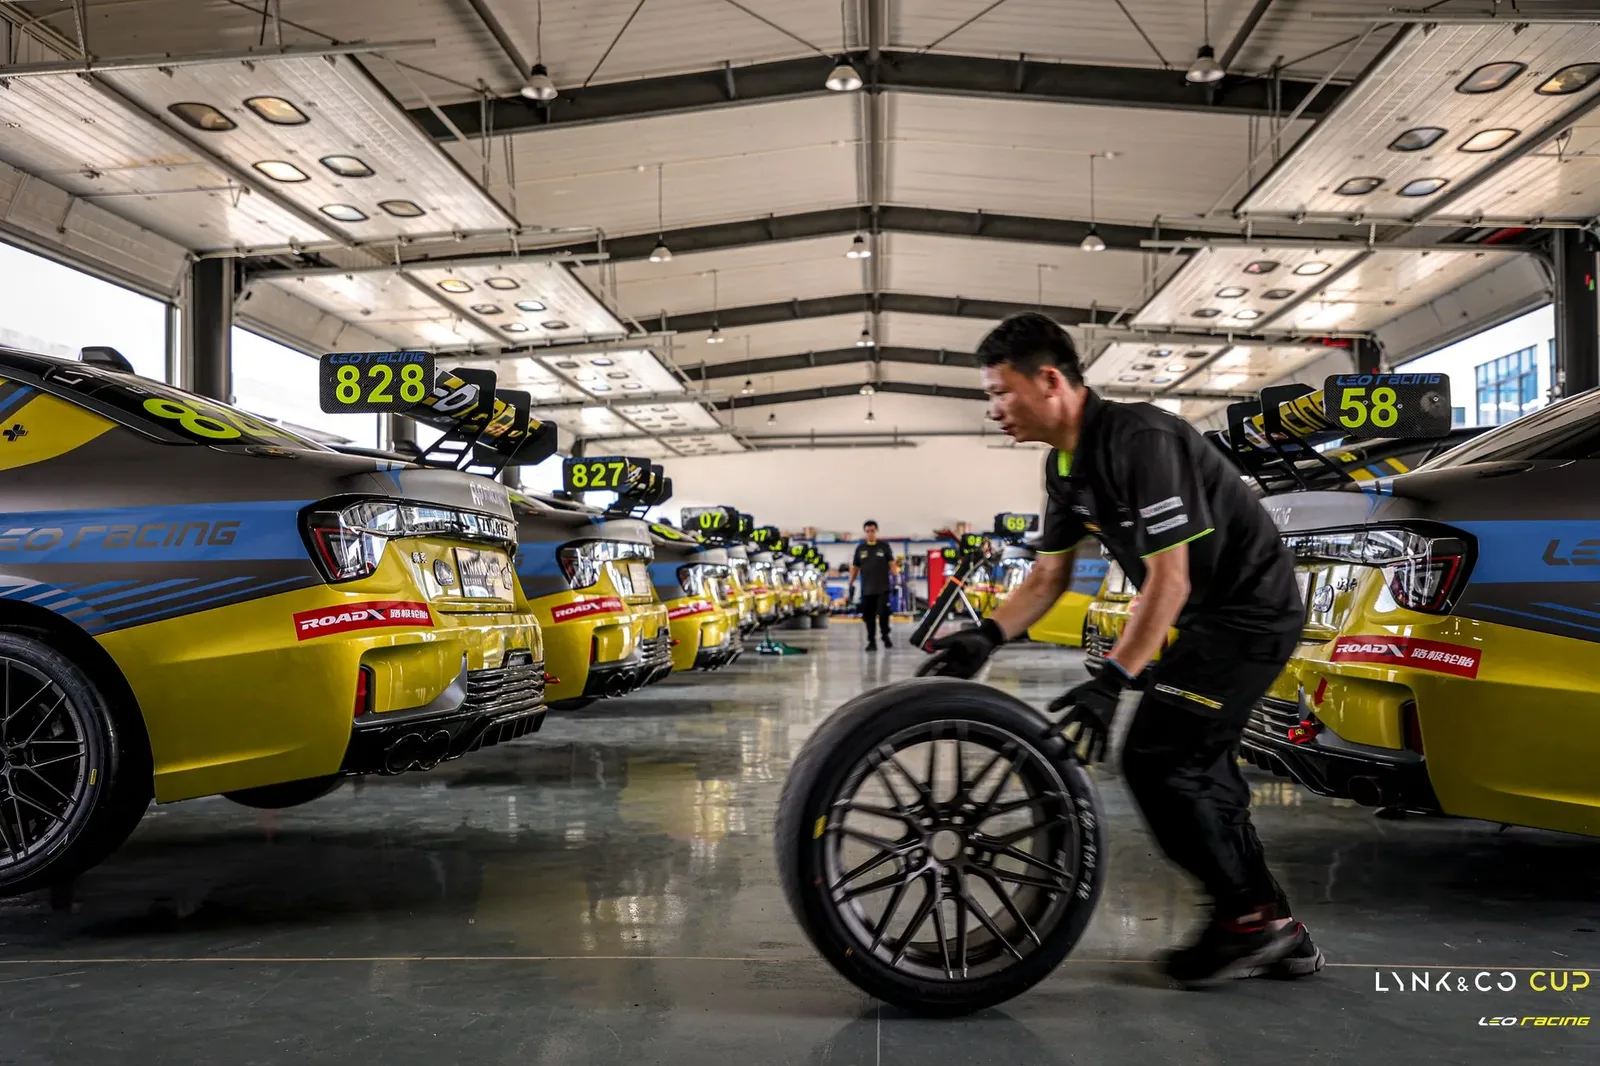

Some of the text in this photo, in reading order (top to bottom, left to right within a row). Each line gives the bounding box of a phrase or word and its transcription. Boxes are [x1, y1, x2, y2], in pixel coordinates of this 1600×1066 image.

[336, 363, 425, 404] 828
[1336, 375, 1373, 386] LEO
[1339, 387, 1398, 428] 58
[572, 463, 624, 488] 827
[700, 512, 722, 529] 07
[1007, 517, 1026, 531] 69
[0, 527, 64, 551] EO
[1542, 538, 1600, 566] LE
[300, 609, 387, 630] ROADX
[1336, 643, 1475, 668] ROADX 路极轮胎
